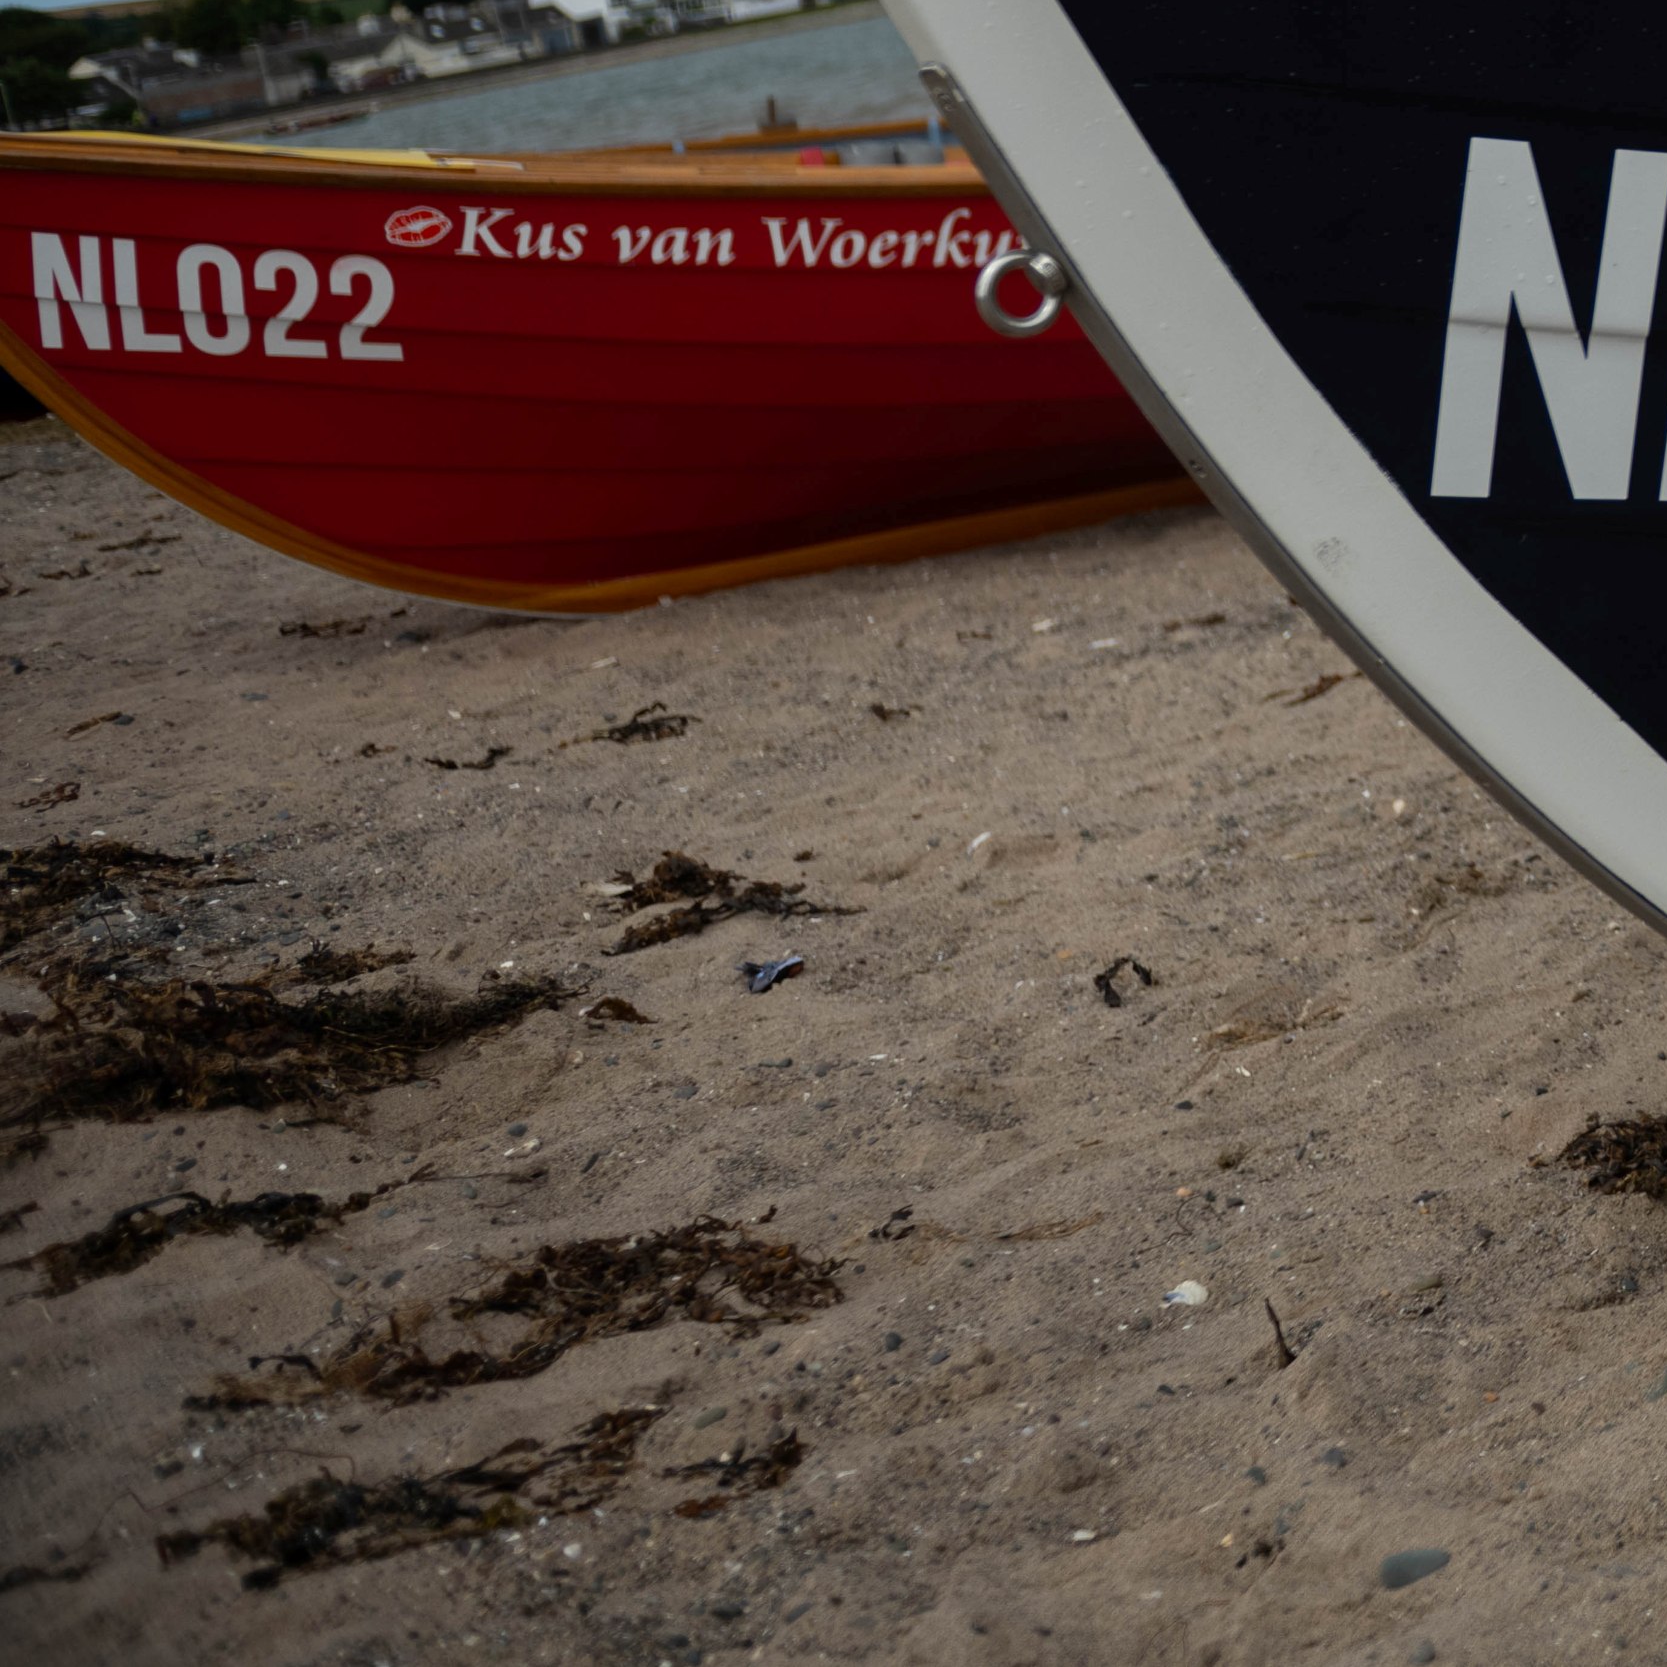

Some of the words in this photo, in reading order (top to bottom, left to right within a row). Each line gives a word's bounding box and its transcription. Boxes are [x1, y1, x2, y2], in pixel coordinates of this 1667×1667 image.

[454, 205, 588, 262] Kus
[611, 224, 737, 267] van
[760, 207, 1032, 269] Woerku
[31, 231, 405, 362] NL022
